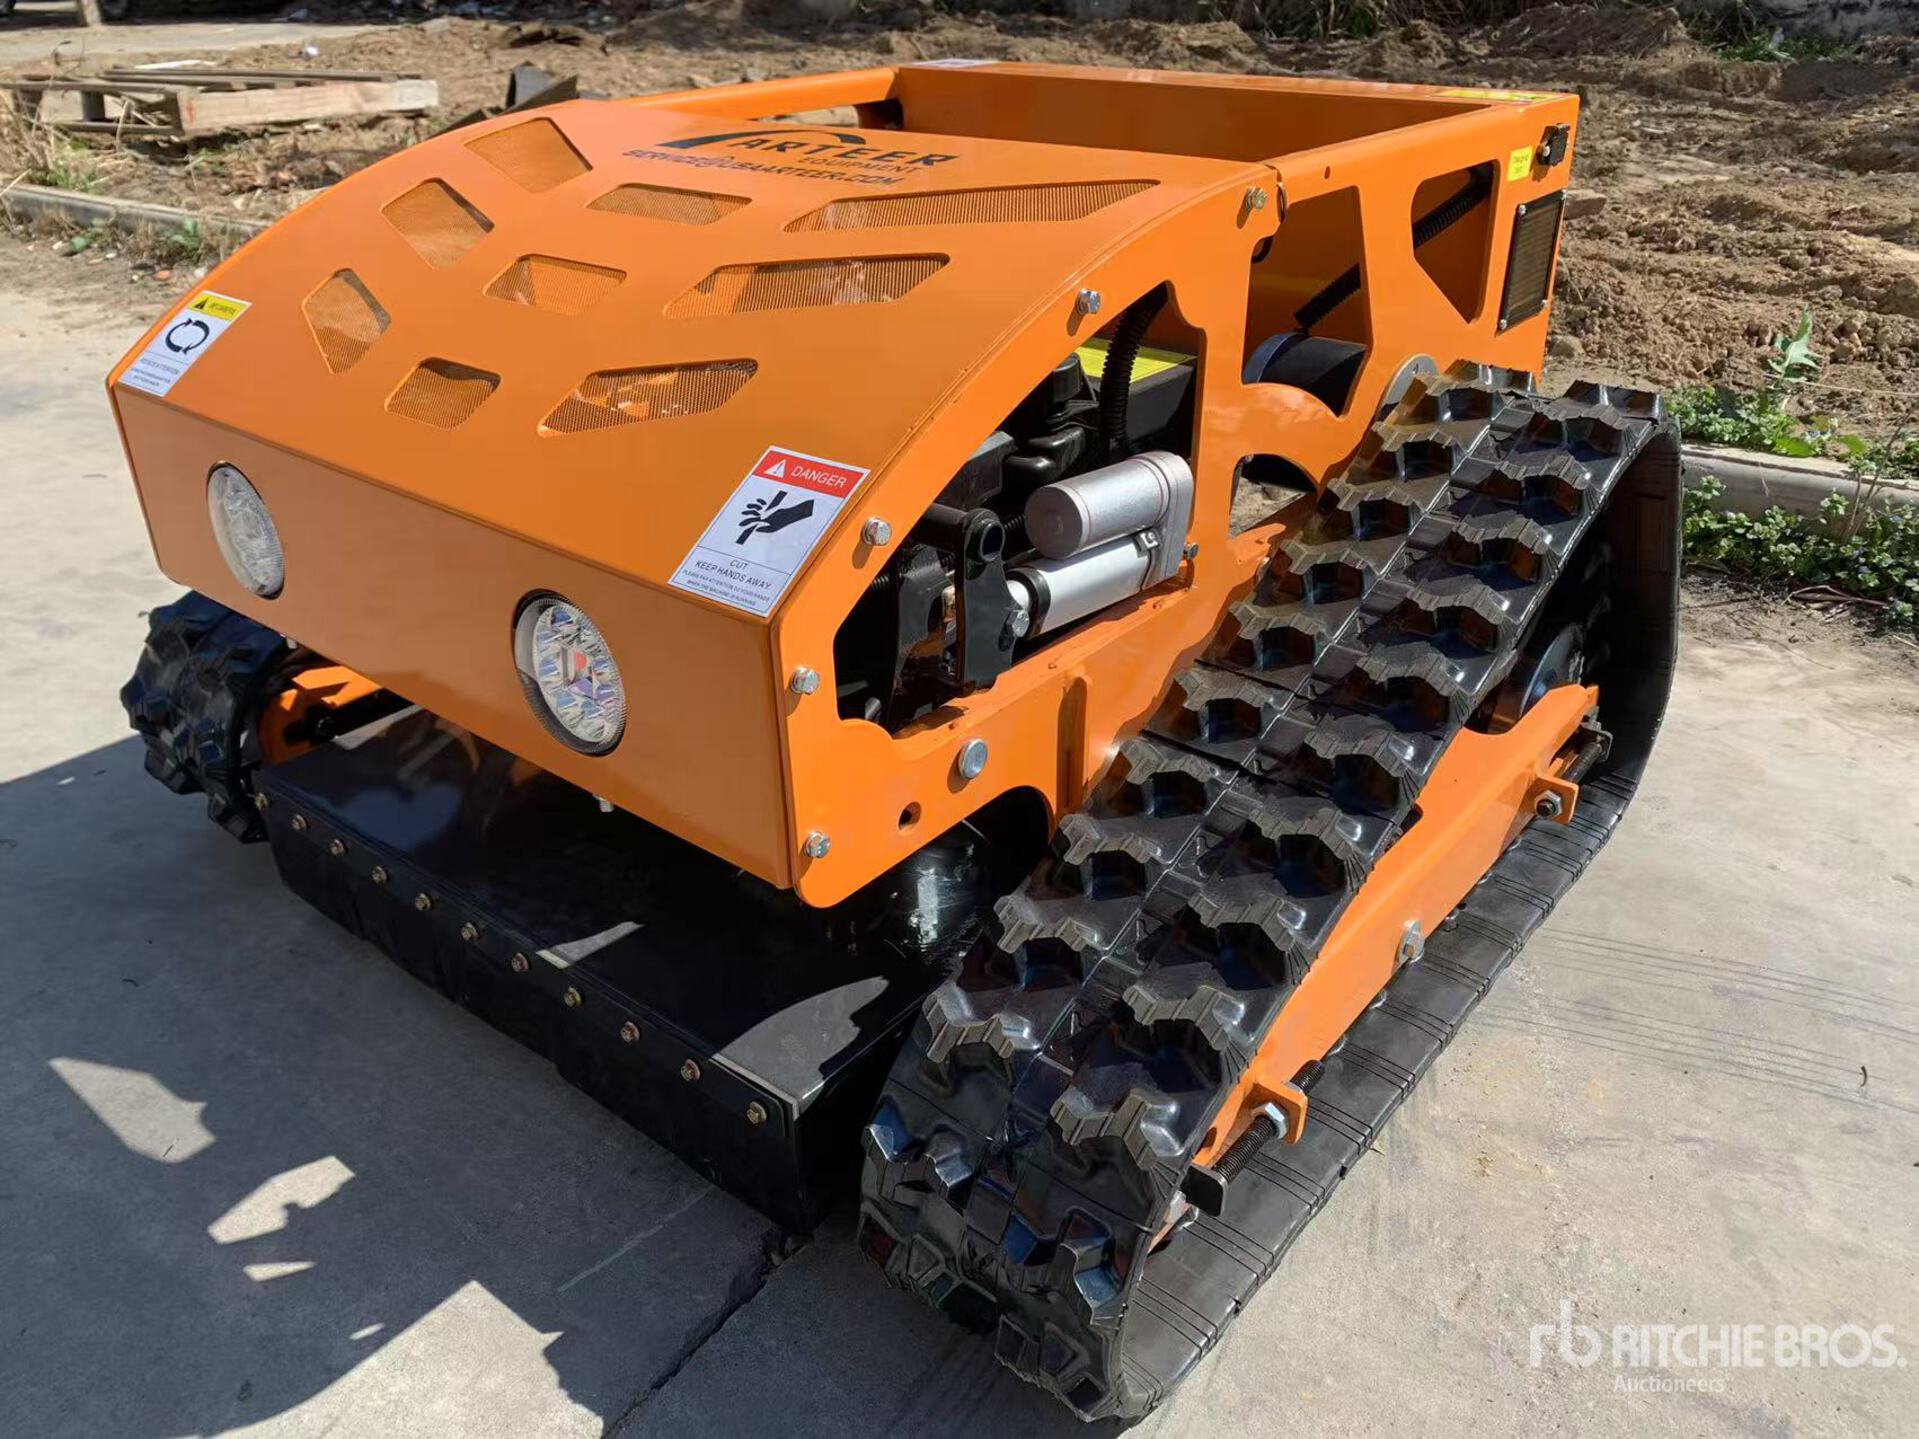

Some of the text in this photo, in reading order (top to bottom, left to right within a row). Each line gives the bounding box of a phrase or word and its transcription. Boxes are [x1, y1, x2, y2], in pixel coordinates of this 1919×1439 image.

[798, 157, 923, 175] EQUIPMENT
[791, 465, 848, 489] DANGER
[696, 560, 772, 590] KEEP HANDS AWAY
[730, 559, 749, 570] CUT
